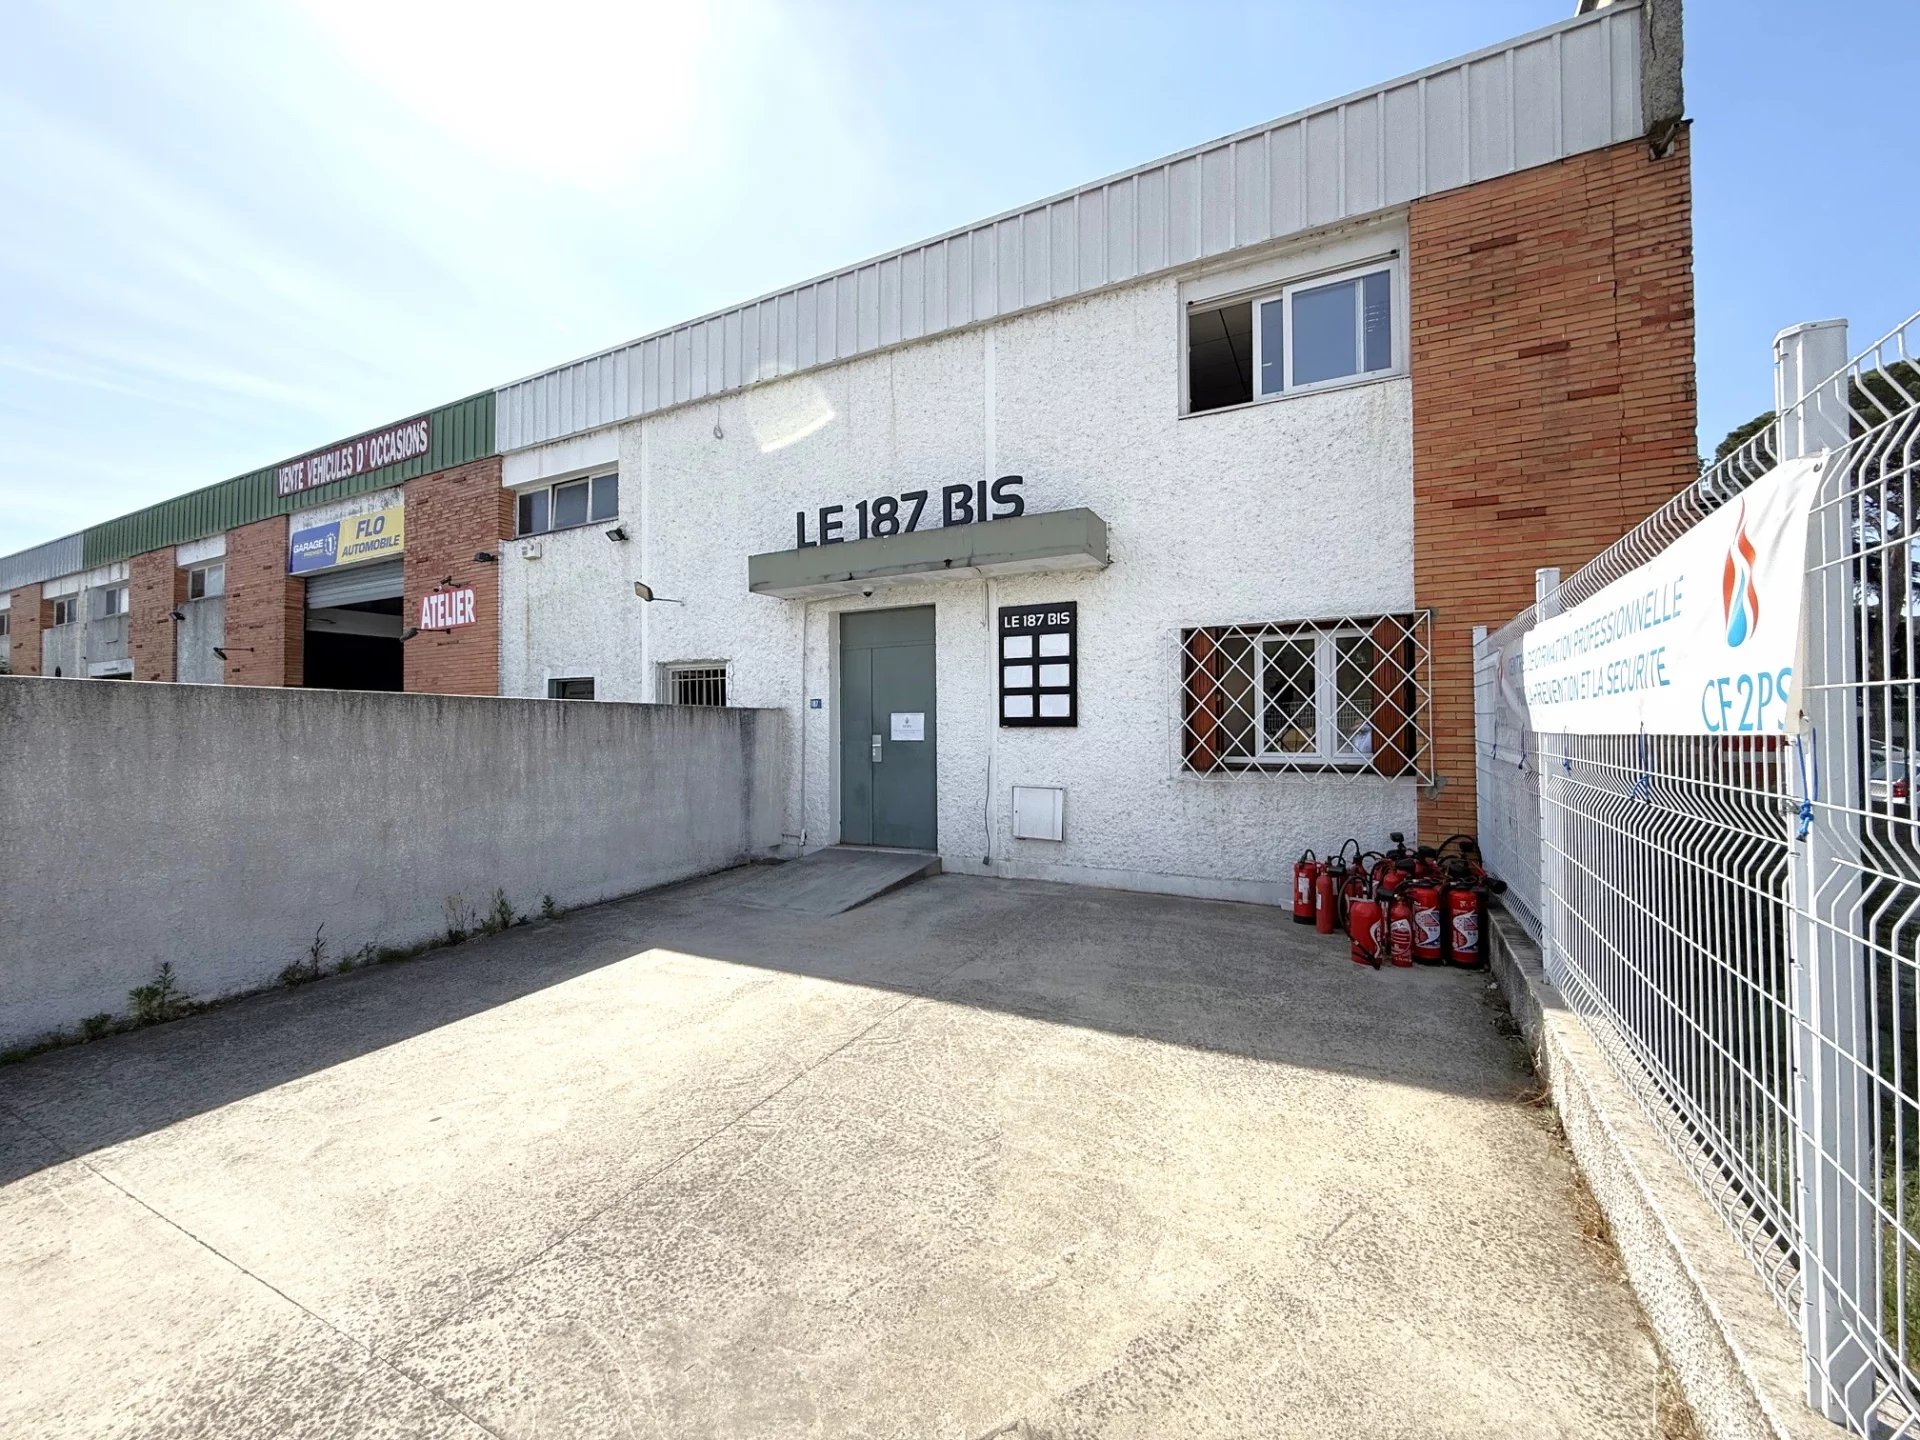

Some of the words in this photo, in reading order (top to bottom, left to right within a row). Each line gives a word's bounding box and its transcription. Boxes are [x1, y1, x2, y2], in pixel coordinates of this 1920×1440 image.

[278, 461, 304, 495] VENTE
[307, 446, 353, 486] VEHICULES
[355, 515, 385, 540] FLO
[796, 505, 844, 549] LE
[855, 490, 928, 539] 187
[942, 475, 1025, 528] BIS
[293, 538, 324, 554] GARAGE
[341, 534, 400, 558] AUTOMOBILE
[421, 589, 476, 630] ATELIER
[1004, 615, 1020, 629] LE
[1023, 613, 1045, 627] 187
[1047, 611, 1071, 626] BIS
[1573, 575, 1684, 657] PROFESSIONNELLE
[1581, 670, 1592, 700] ET
[1592, 666, 1604, 698] LA
[1606, 646, 1671, 696] SECURITE
